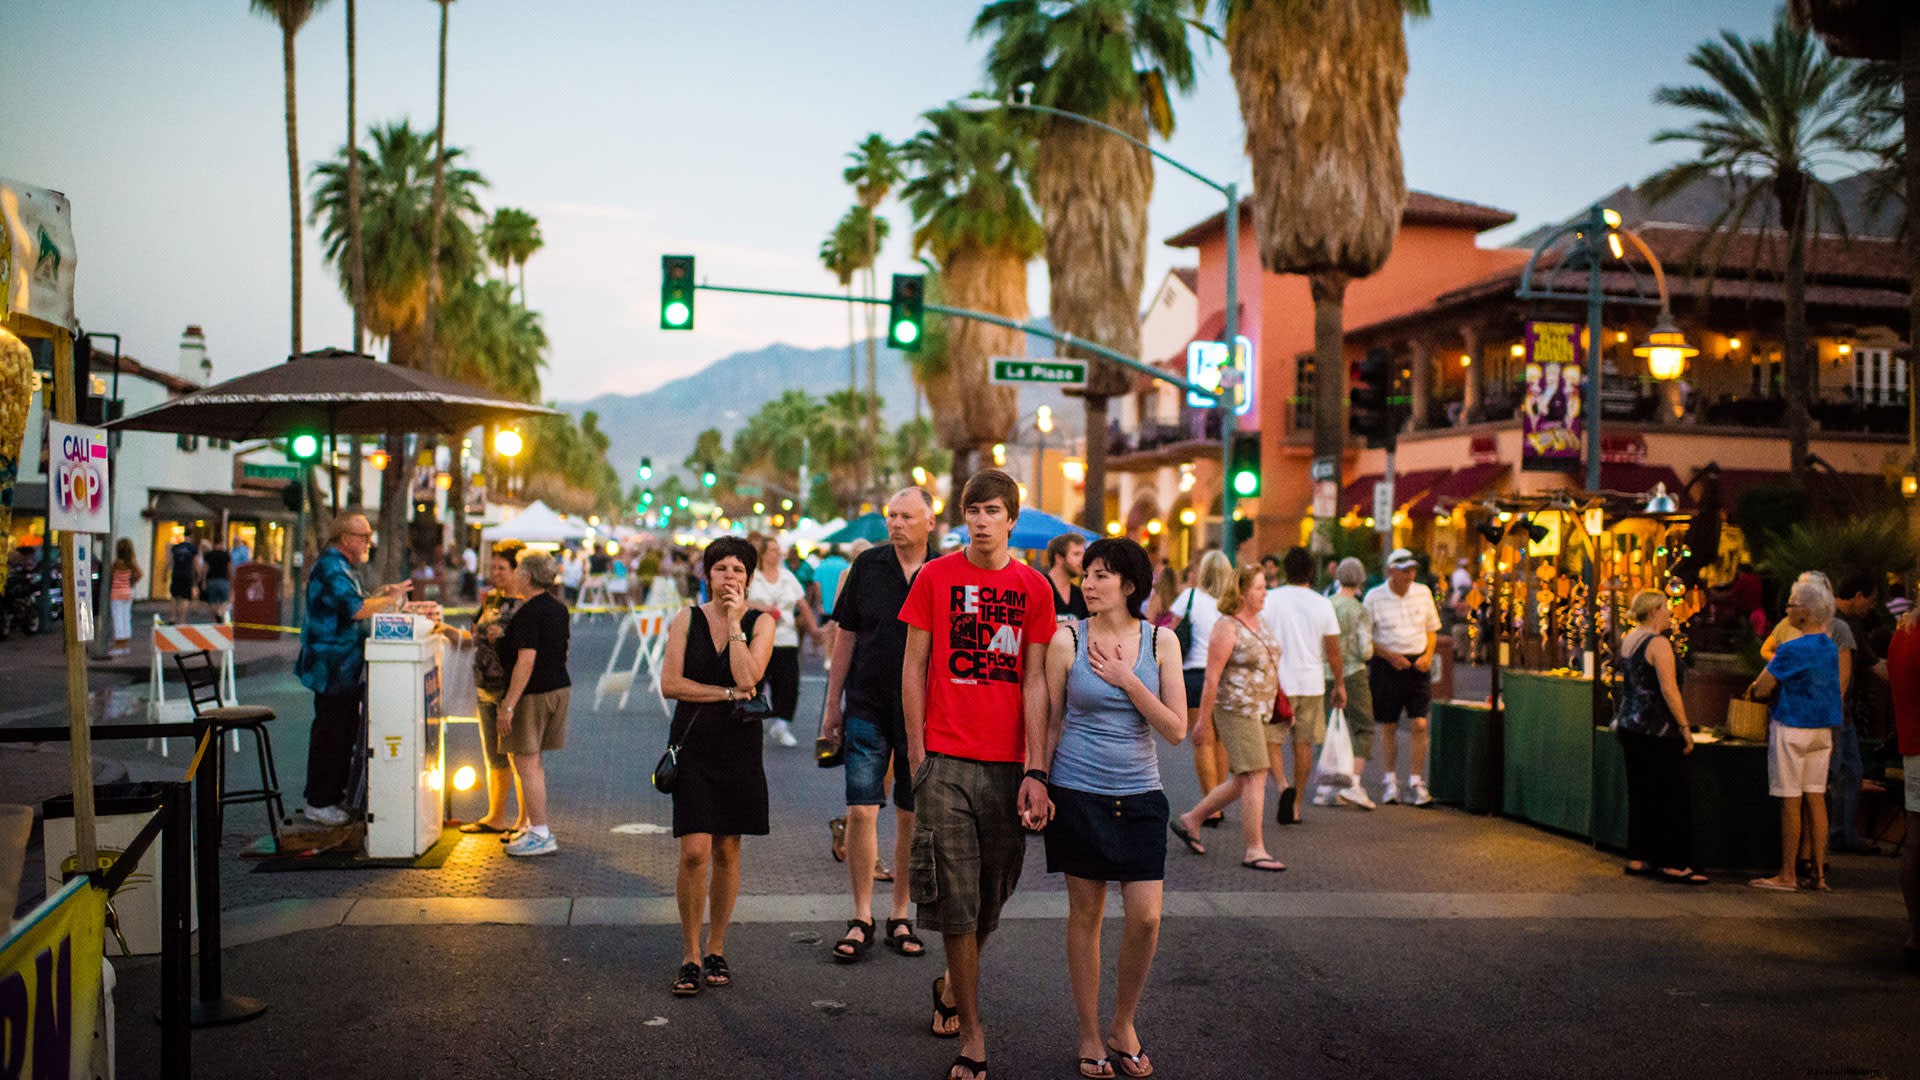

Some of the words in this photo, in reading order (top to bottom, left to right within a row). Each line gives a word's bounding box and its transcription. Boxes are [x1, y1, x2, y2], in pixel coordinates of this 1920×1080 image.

[1006, 365, 1025, 378] La
[1031, 365, 1073, 380] Plaza
[63, 434, 90, 463] CALI
[60, 465, 100, 510] POP
[951, 585, 1026, 612] RECLAIM
